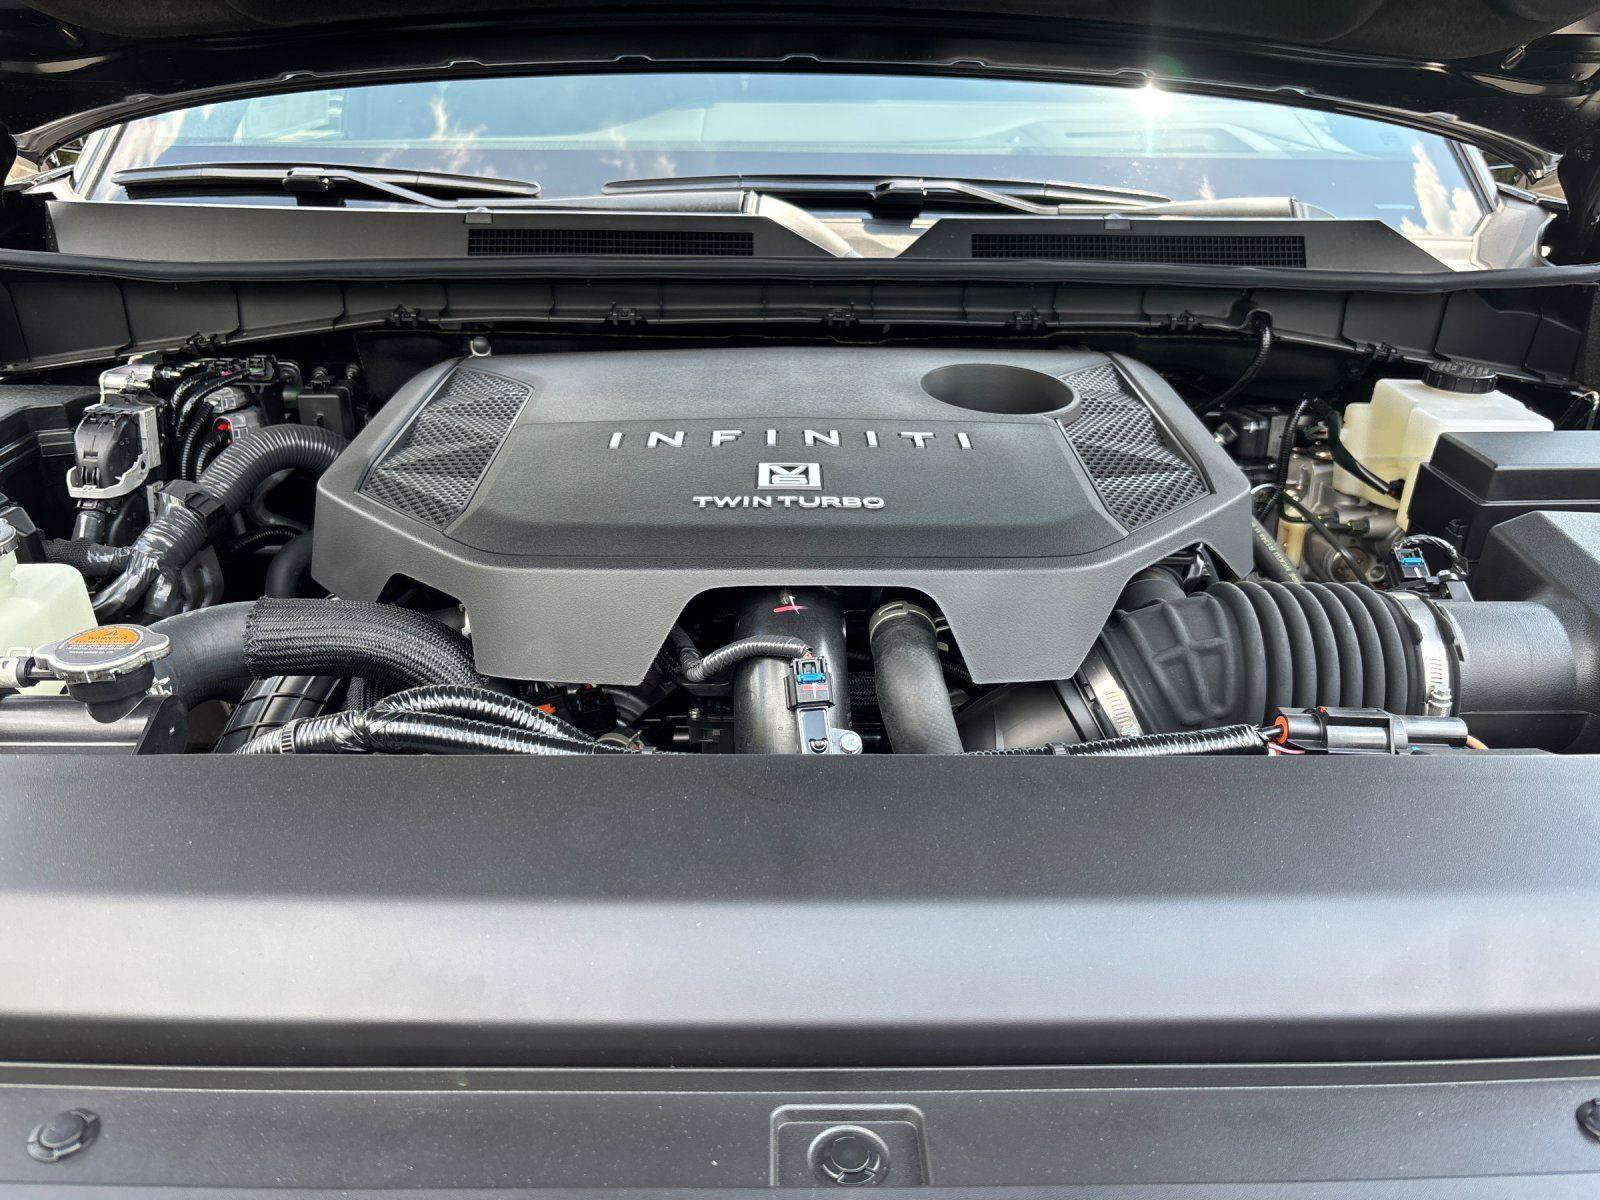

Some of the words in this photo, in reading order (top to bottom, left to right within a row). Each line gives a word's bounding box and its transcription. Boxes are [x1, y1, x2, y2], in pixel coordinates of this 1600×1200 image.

[608, 429, 972, 449] INFINITI
[692, 495, 772, 508] TWIN
[777, 495, 885, 509] TURBO
